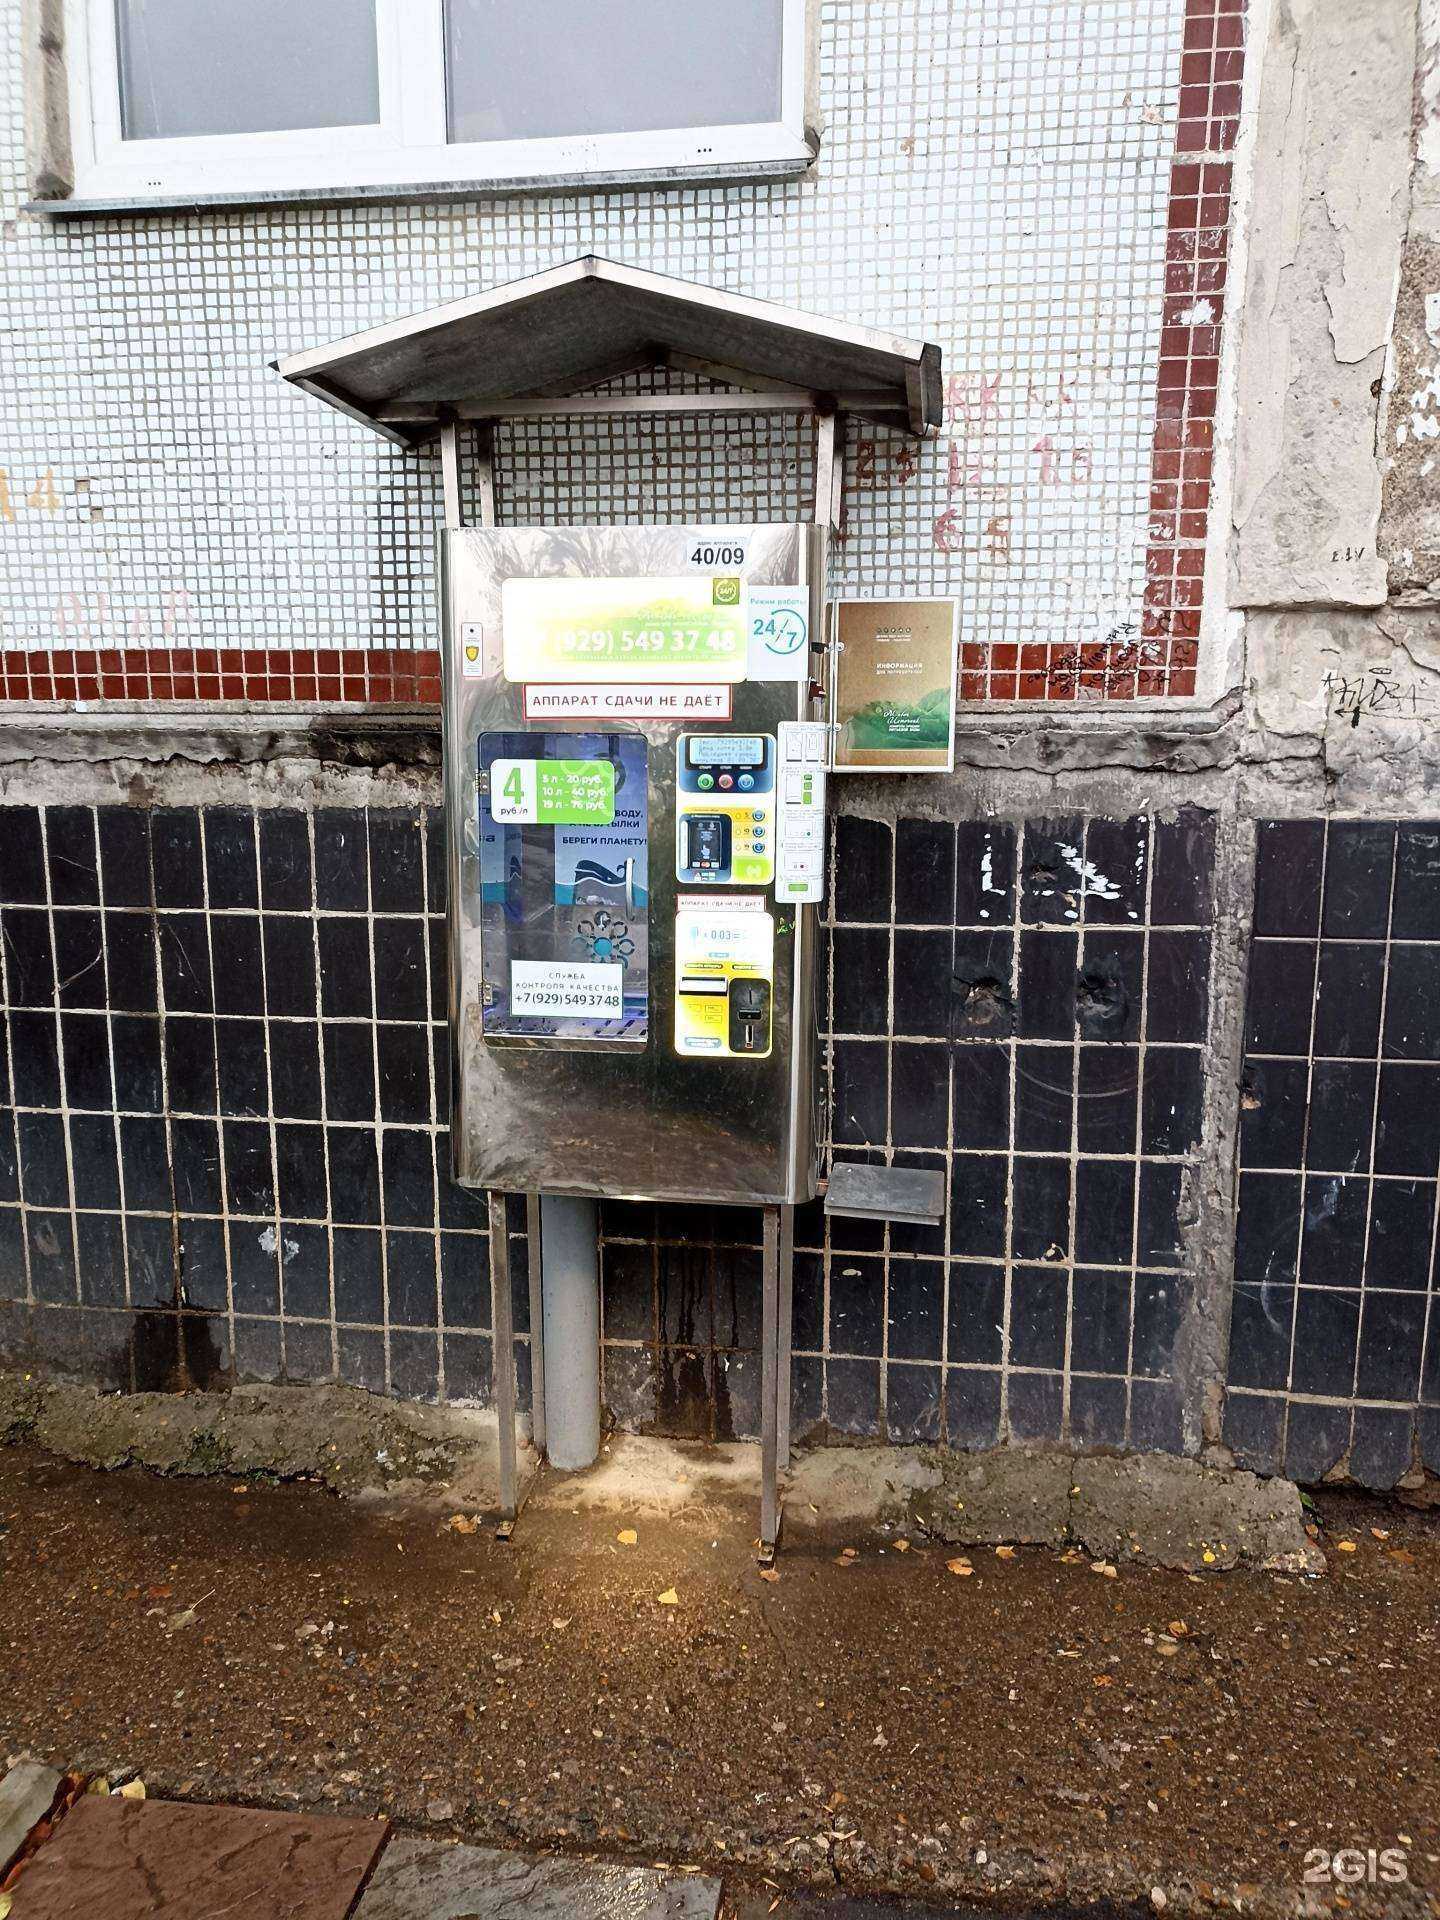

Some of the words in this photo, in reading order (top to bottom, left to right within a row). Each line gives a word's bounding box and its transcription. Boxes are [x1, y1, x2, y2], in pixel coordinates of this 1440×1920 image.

[691, 547, 745, 565] 40/09
[750, 597, 775, 605] Режим
[620, 629, 665, 651] 549
[670, 629, 700, 651] 37
[705, 629, 736, 651] 48
[532, 695, 599, 706] АППАРАТ
[605, 695, 653, 707] СДАЧИ
[659, 695, 678, 706] НЕ
[684, 693, 723, 707] ДАЁТ
[566, 774, 580, 784] 20
[503, 767, 525, 805] 4
[543, 788, 554, 796] 10
[571, 788, 585, 796] 40
[562, 836, 598, 844] БЕРЕГИ
[599, 837, 647, 846] ПЛАНЕТУ!
[549, 972, 586, 980] СЛУЖБА
[515, 982, 565, 990] КОНТРОЛЯ
[570, 984, 620, 992] КАЧЕСТВА
[515, 992, 620, 1007] +7(929)5493748
